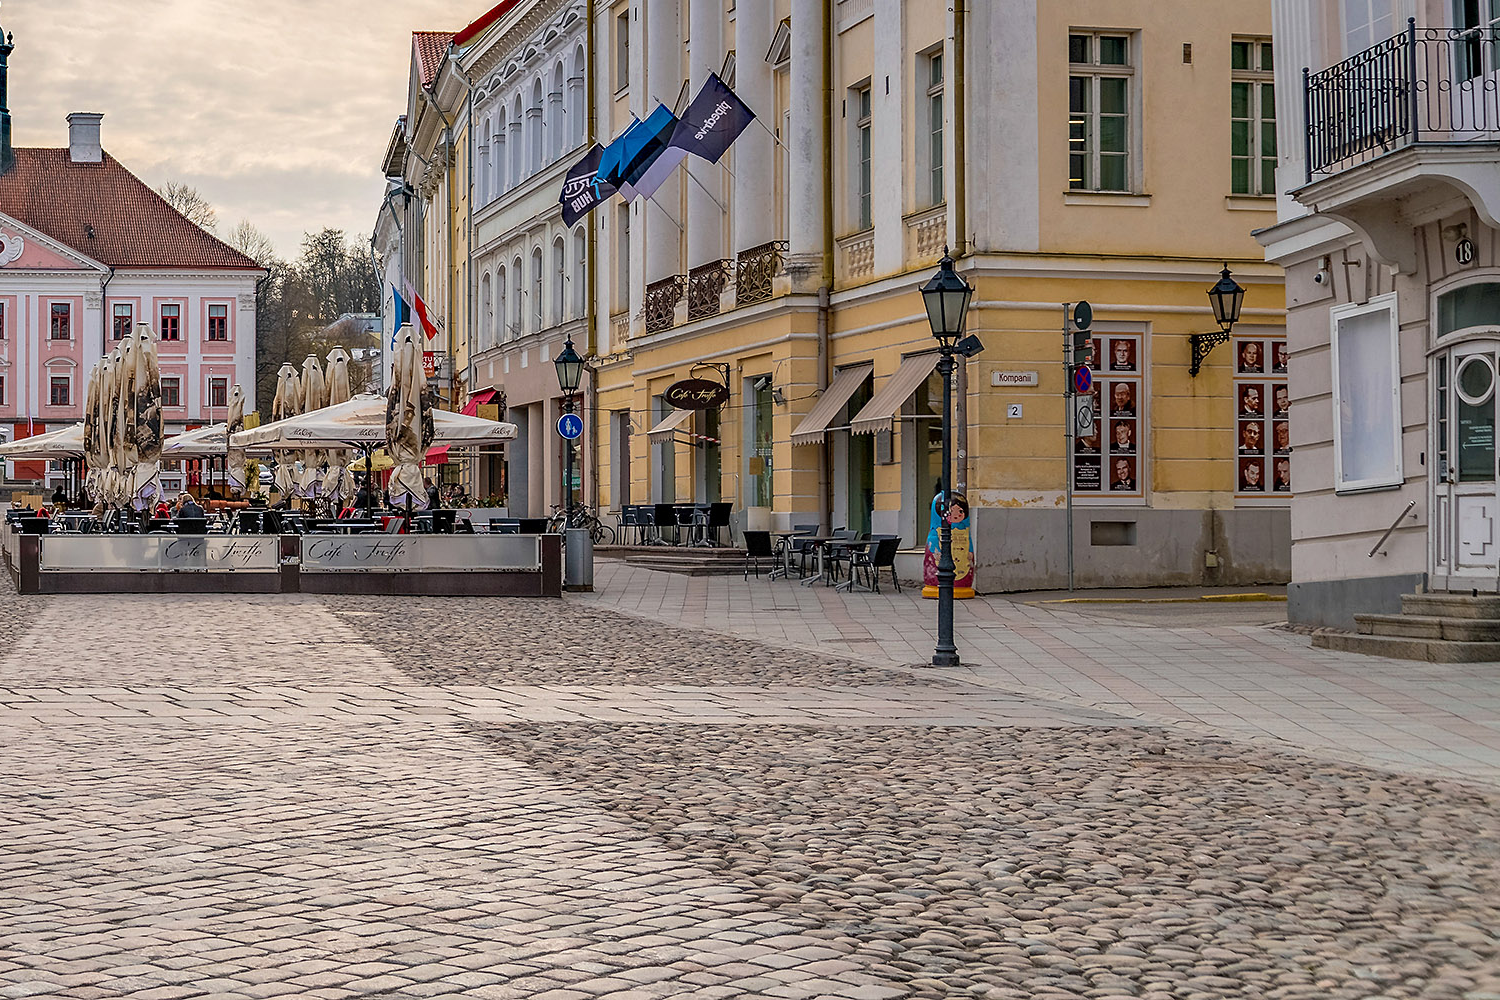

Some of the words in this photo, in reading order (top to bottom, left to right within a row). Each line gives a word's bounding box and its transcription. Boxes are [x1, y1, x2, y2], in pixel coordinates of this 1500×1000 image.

[1458, 241, 1471, 262] 18
[998, 373, 1032, 383] Kompanii
[1011, 406, 1018, 416] 2
